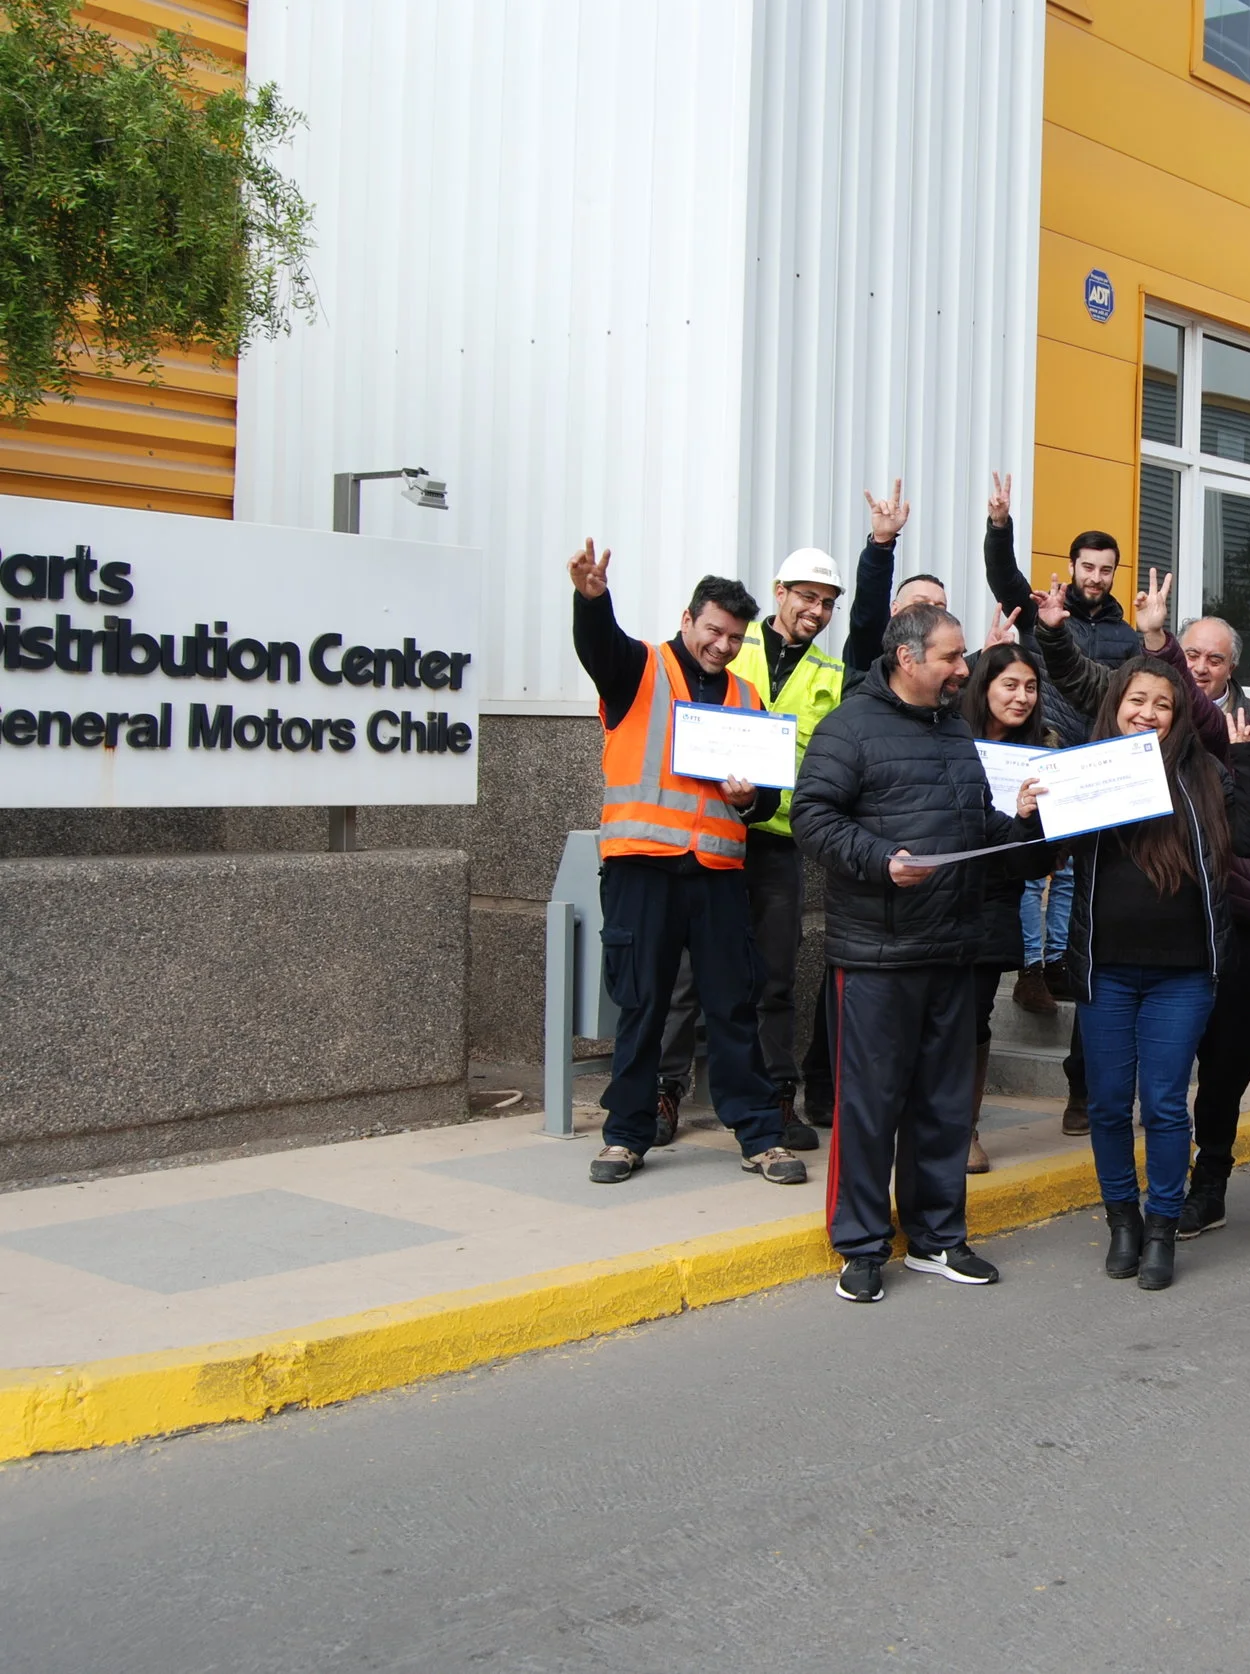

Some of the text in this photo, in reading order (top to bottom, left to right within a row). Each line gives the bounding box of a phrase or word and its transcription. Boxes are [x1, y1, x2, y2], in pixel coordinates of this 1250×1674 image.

[1089, 285, 1110, 306] ADT
[0, 544, 134, 605] arts
[0, 607, 472, 690] istribution Center
[0, 702, 473, 753] eneral Motors Chile
